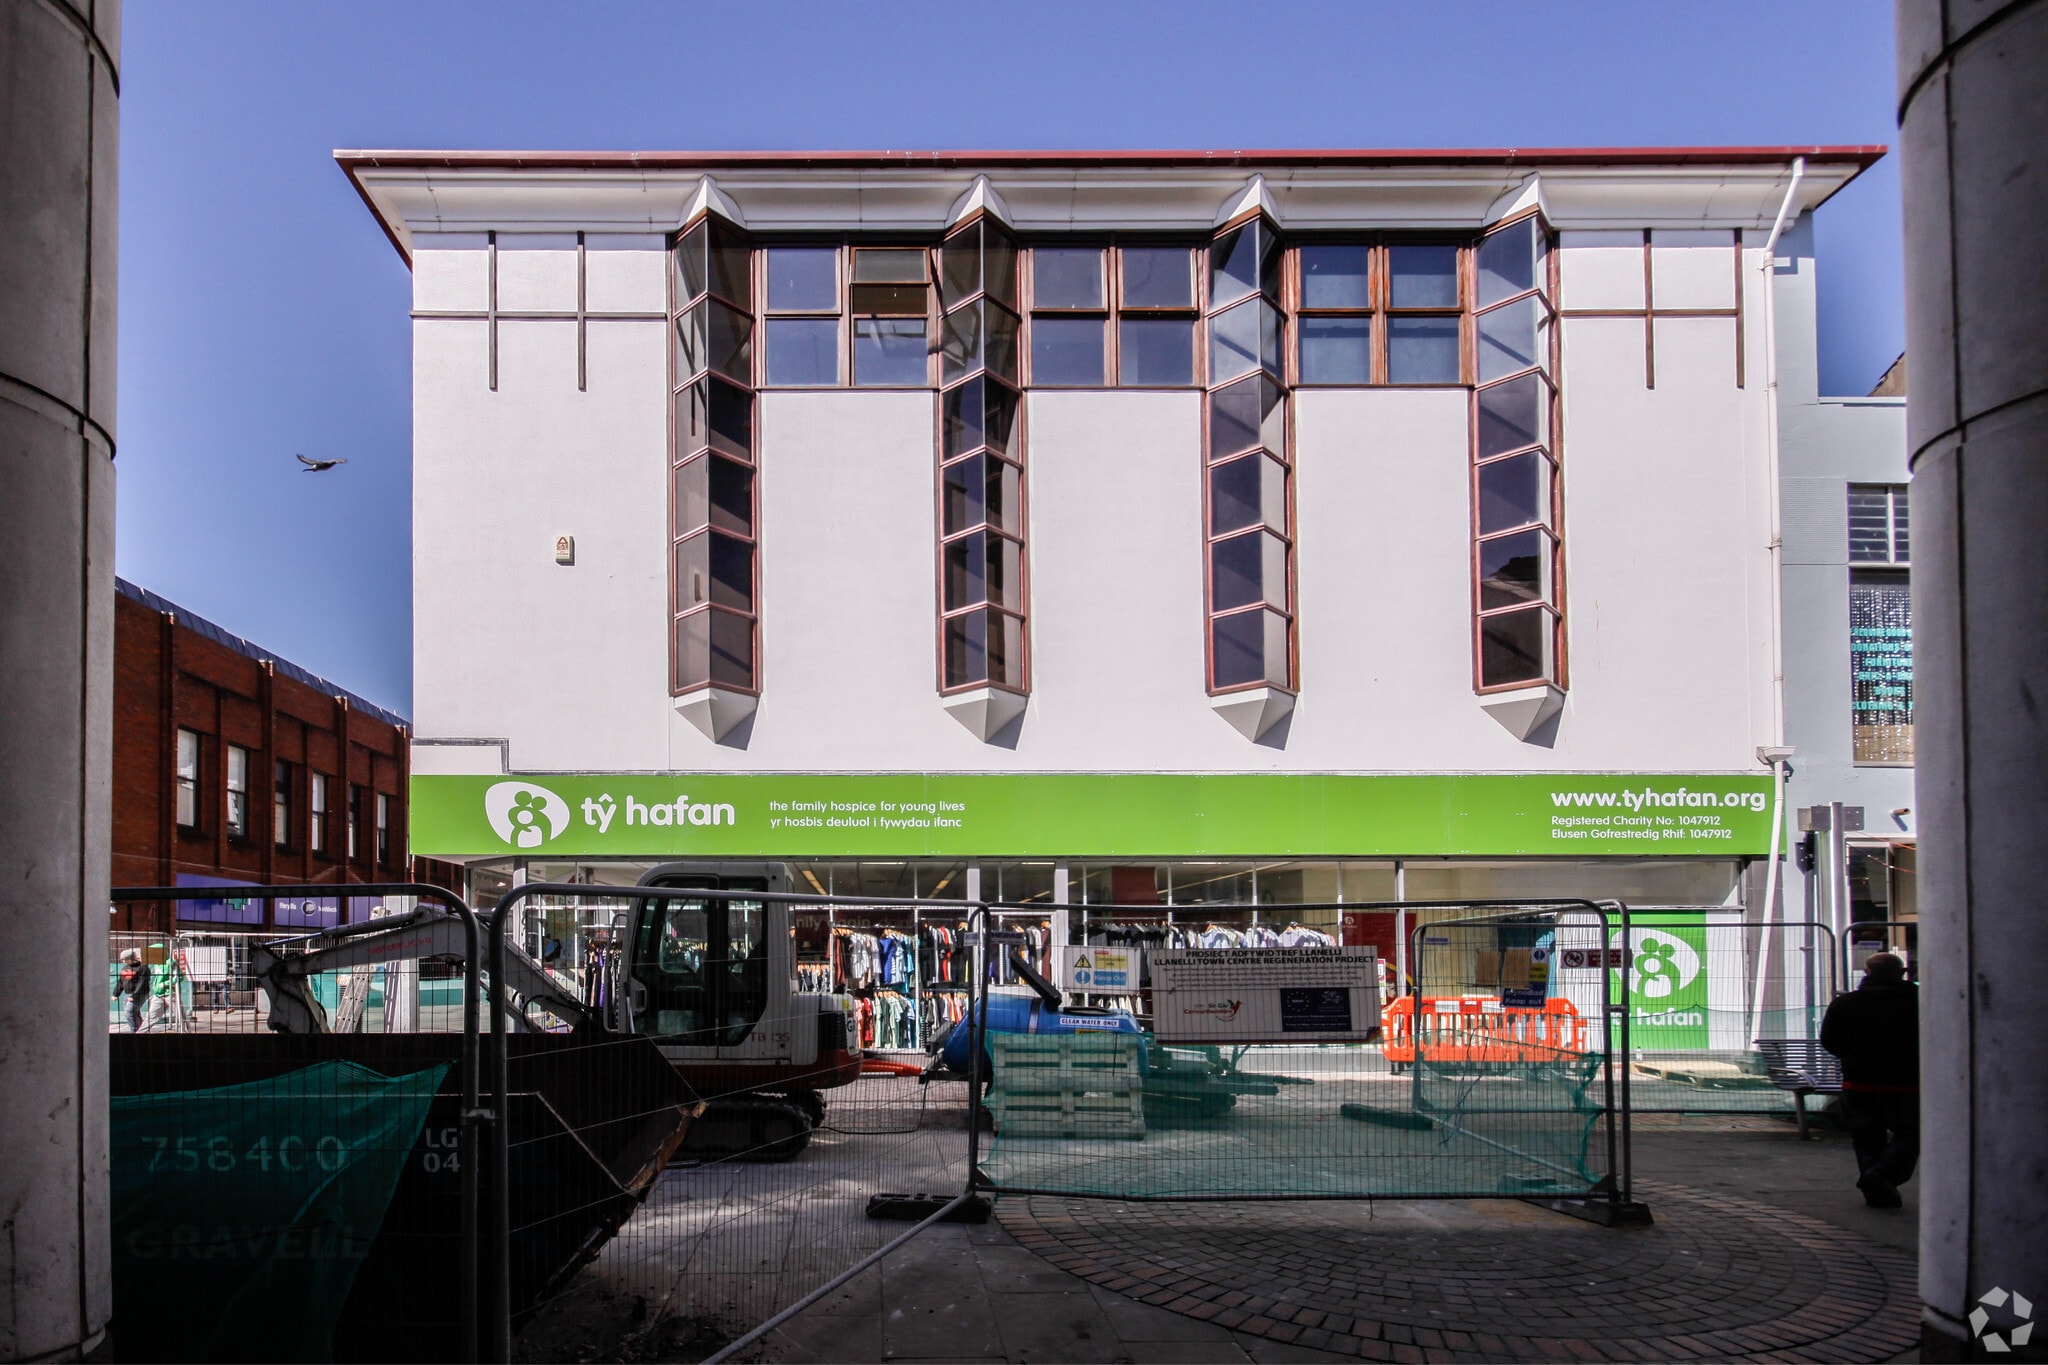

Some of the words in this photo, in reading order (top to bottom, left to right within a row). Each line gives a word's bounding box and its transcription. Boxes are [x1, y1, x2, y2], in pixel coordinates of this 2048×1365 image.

[1551, 787, 1766, 813] www.tyhafan.org
[581, 793, 617, 834] tŷ
[626, 795, 736, 827] hafan
[769, 800, 788, 811] the
[791, 801, 827, 813] family
[830, 801, 876, 814] hospice
[880, 801, 896, 812] for
[899, 804, 936, 815] young
[939, 800, 965, 812] lives
[770, 819, 782, 829] yr
[785, 817, 823, 827] hosbis
[825, 817, 870, 827] deuluol
[879, 817, 931, 830] fywydau
[933, 816, 962, 828] ifanc
[1551, 815, 1610, 828] Registered
[1613, 816, 1653, 828] Charity
[1656, 816, 1675, 826] No:
[1679, 816, 1721, 826] 1047912
[1551, 829, 1588, 839] Elusen
[1590, 829, 1660, 841] Gofrestredig
[1662, 829, 1686, 839] Rhif:
[1689, 829, 1732, 839] 1047912
[1186, 950, 1230, 959] PROSIECT
[1231, 949, 1275, 957] ADFYWIO
[1275, 949, 1298, 957] TREF
[1300, 948, 1342, 957] LLANELLI
[1154, 957, 1196, 966] LLANELLI
[1196, 957, 1225, 965] TOWN
[1227, 956, 1262, 965] CENTRE
[1264, 955, 1333, 964] REGENERATION
[1335, 955, 1375, 964] PROJECT
[1094, 974, 1112, 982] Keep
[1504, 997, 1526, 1005] Keep
[1636, 1007, 1703, 1026] hafan
